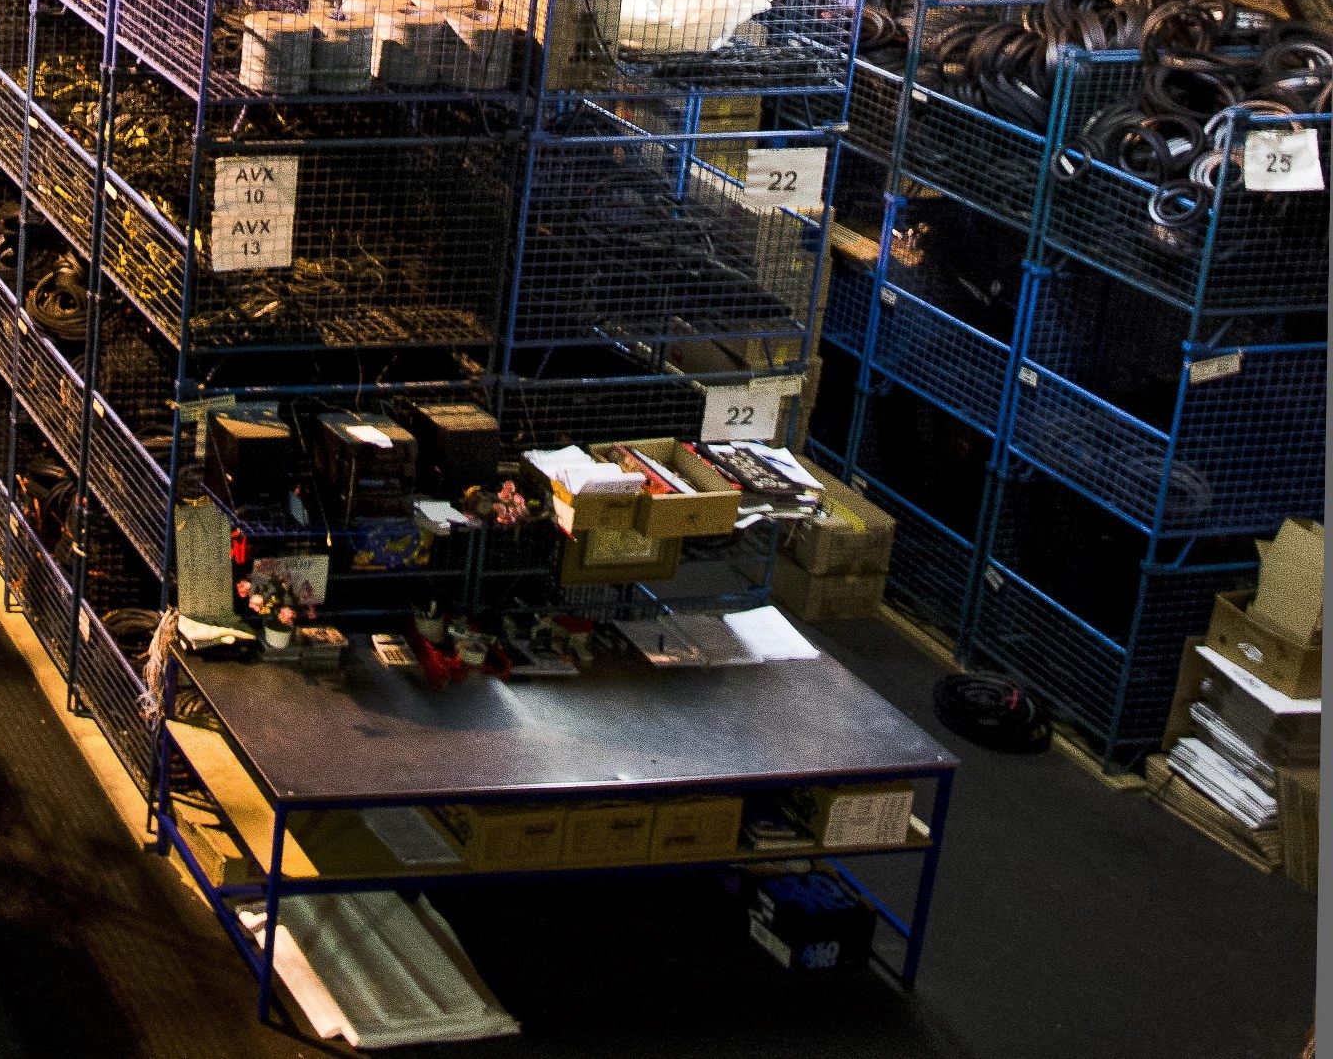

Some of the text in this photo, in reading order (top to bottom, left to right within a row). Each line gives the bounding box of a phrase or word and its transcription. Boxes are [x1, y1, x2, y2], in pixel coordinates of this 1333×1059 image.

[1266, 154, 1293, 174] 25
[235, 167, 274, 183] AVX
[768, 172, 797, 192] 22
[246, 188, 264, 204] 10
[232, 221, 272, 236] AVX
[242, 241, 261, 255] 13
[725, 407, 755, 425] 22
